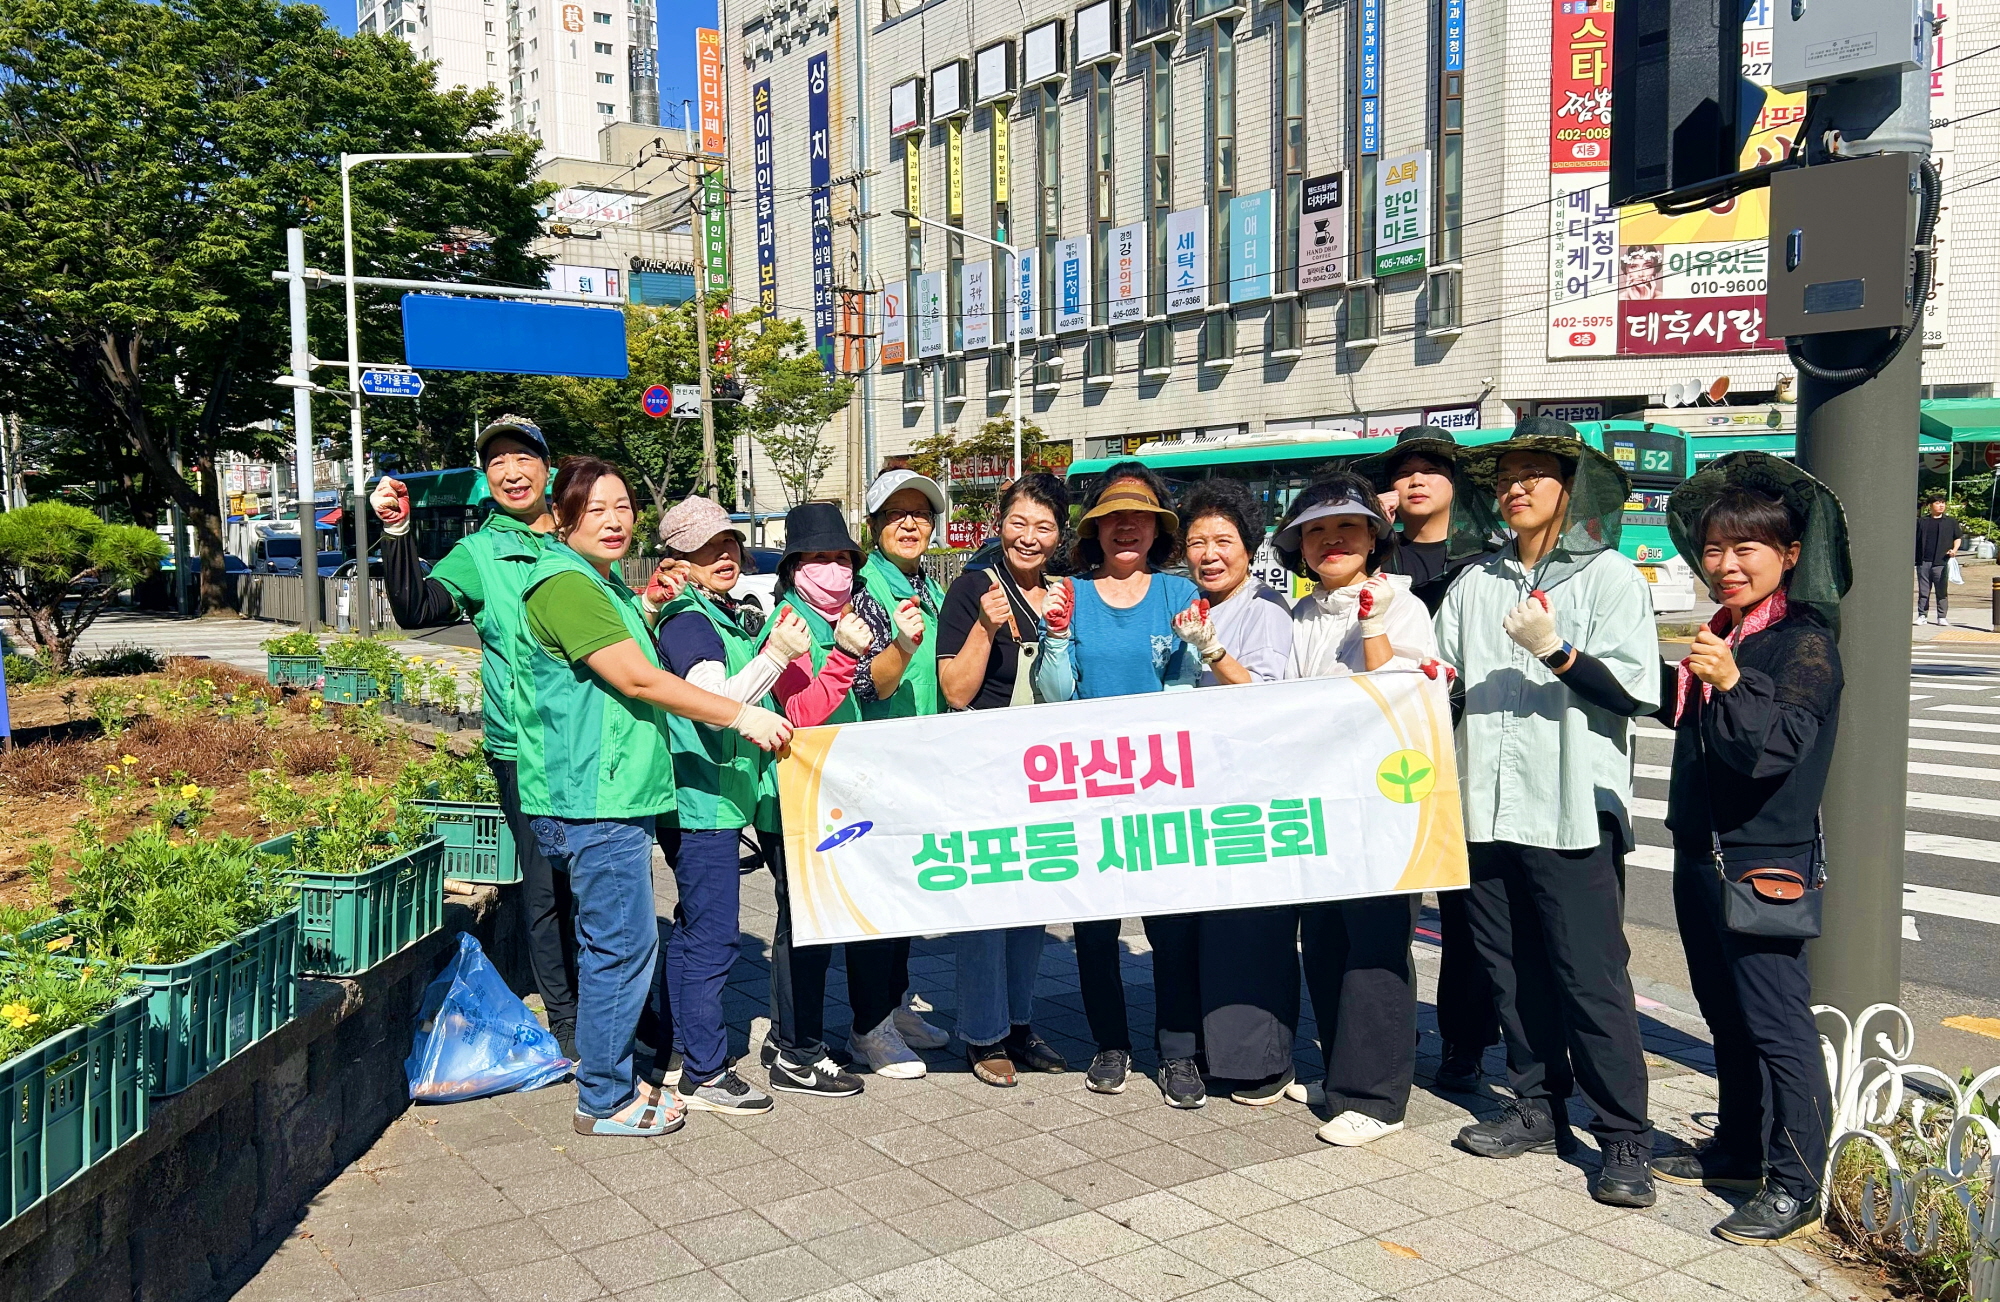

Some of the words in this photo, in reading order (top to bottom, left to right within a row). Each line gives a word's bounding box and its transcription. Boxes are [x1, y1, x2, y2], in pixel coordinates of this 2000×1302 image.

[699, 32, 719, 46] 스타
[1569, 17, 1608, 86] 스타
[703, 46, 720, 134] 스터디카페
[1557, 87, 1613, 125] 짬뽕
[1364, 101, 1374, 150] 장애진단
[1556, 126, 1611, 142] 402-009
[706, 137, 719, 149] 4F
[1575, 144, 1596, 157] 지층
[1385, 160, 1418, 186] 스타
[1307, 190, 1337, 208] 더치커피
[1384, 188, 1418, 219] 할인
[1384, 217, 1419, 244] 마트
[1566, 188, 1591, 299] 메디케어
[1591, 203, 1616, 284] 보청기
[1120, 242, 1132, 256] 강
[1177, 231, 1195, 288] 세탁소
[1244, 215, 1257, 283] 애터미
[1379, 253, 1423, 269] 405-7496~7
[643, 258, 665, 269] THE
[1669, 247, 1766, 278] 이유있는
[711, 273, 724, 284] B1
[1065, 261, 1077, 312] 보청기
[1120, 256, 1132, 298] 한의원
[1554, 259, 1565, 301] 장애진단
[1690, 279, 1767, 295] 010-9600
[1552, 316, 1613, 328] 402-5975
[1573, 334, 1592, 345] 3층
[373, 373, 411, 387] 항가울로
[1429, 411, 1476, 428] 스타잡화
[1644, 450, 1670, 471] 52
[1023, 730, 1195, 804] 안산시
[911, 822, 1079, 892] 성포동
[1097, 797, 1329, 875] 새마을회
